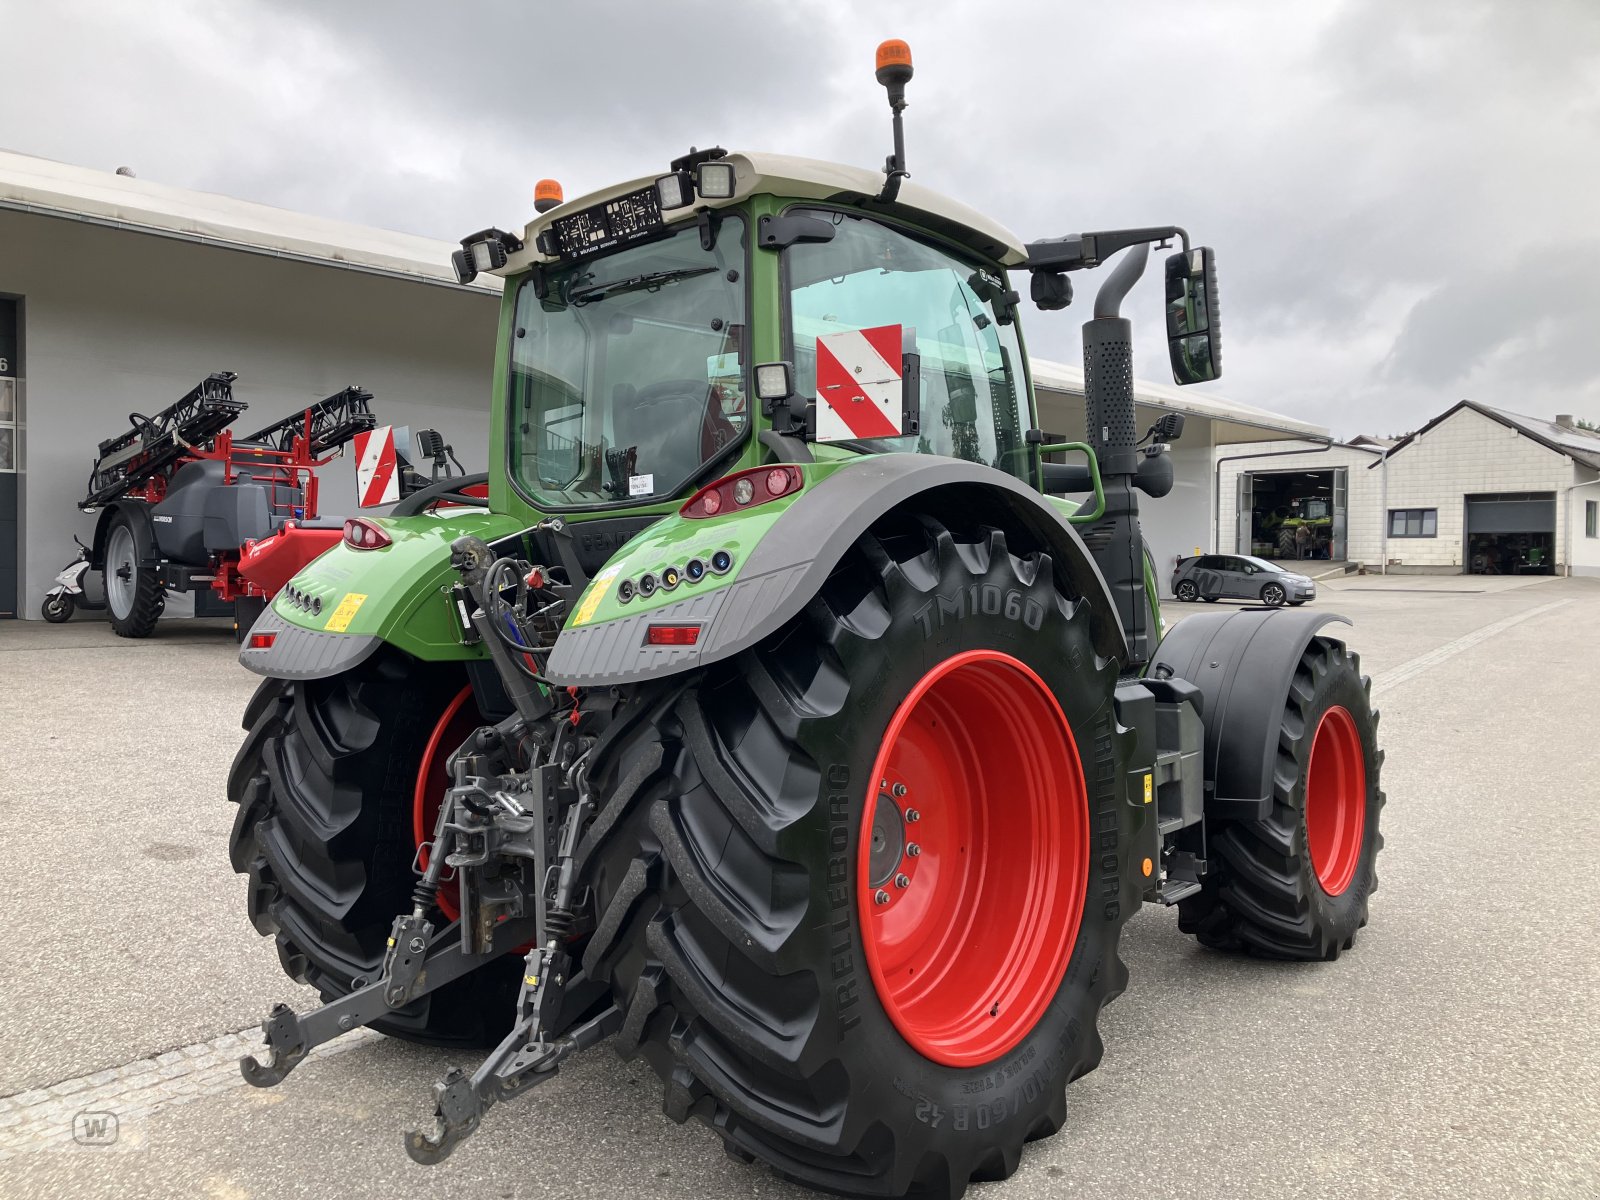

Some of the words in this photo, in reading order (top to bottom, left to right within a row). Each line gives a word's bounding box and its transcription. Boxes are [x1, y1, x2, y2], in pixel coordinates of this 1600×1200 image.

[912, 583, 1045, 640] TM1060
[1094, 710, 1121, 922] TRELLEBORG
[827, 763, 862, 1045] TRELLEBORG
[914, 1095, 946, 1129] 42
[952, 1103, 969, 1131] R
